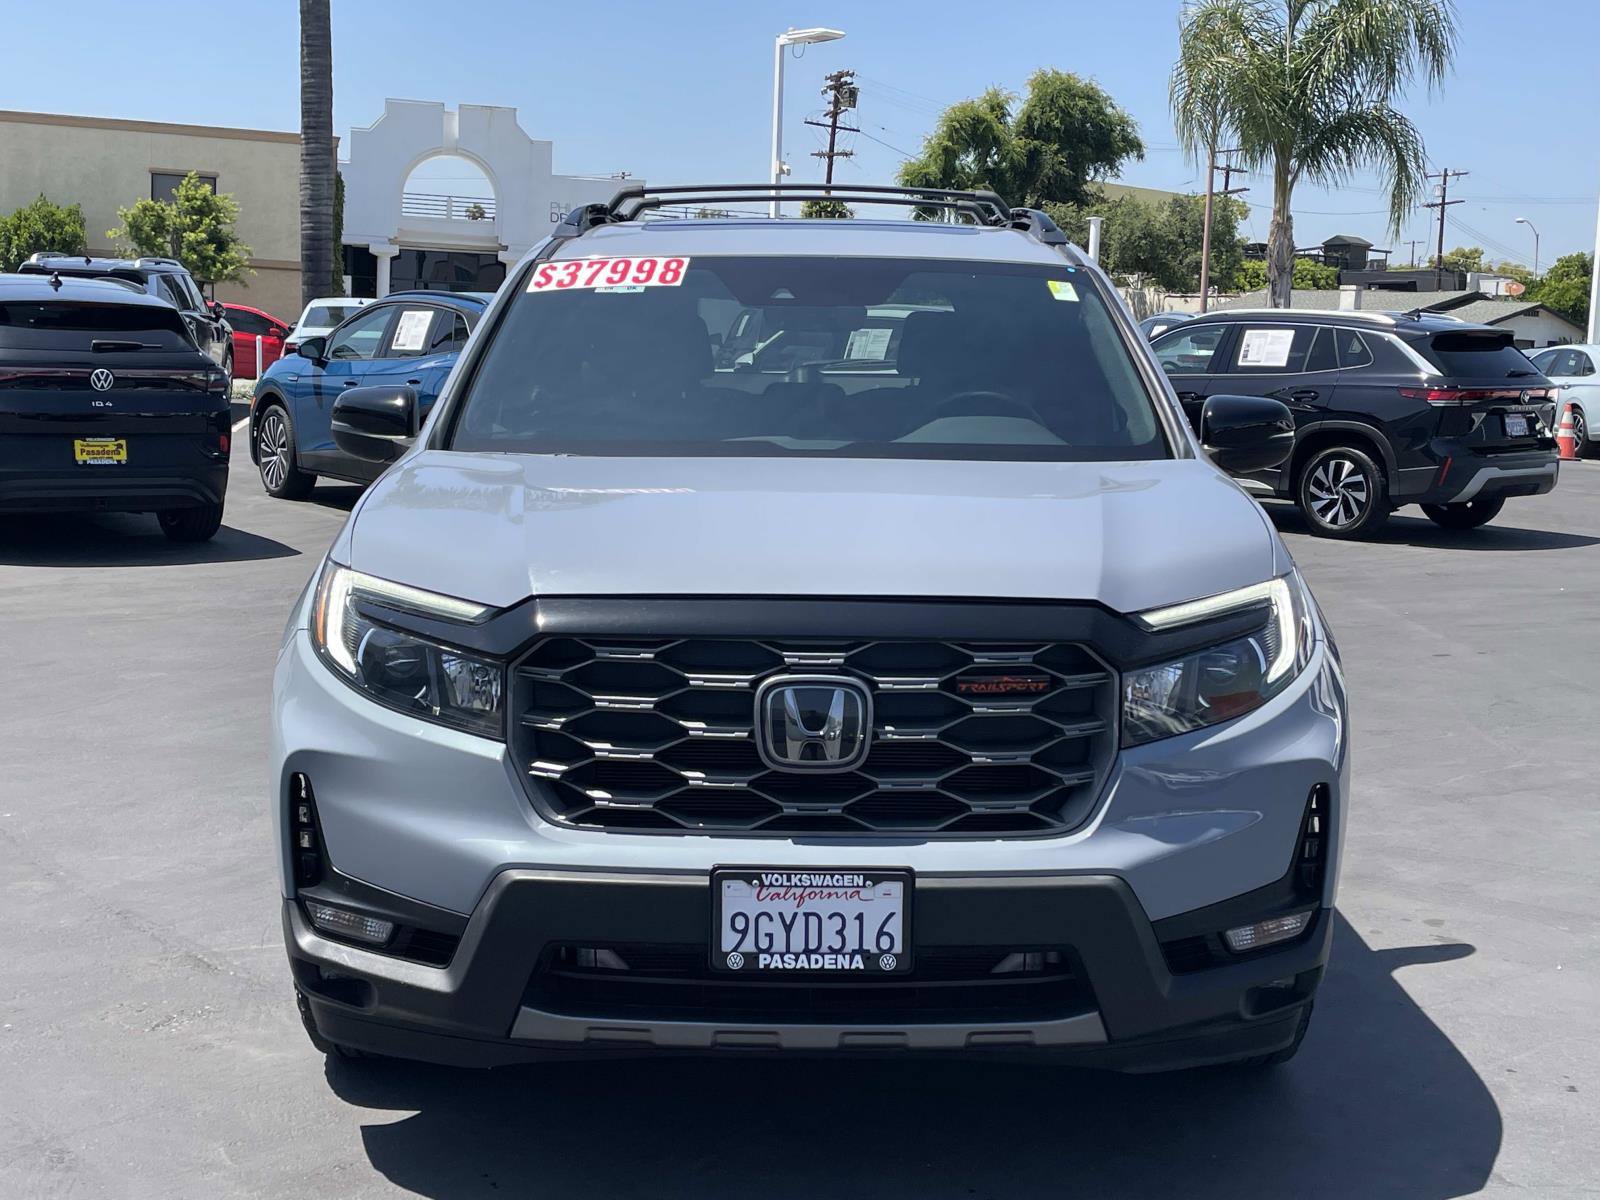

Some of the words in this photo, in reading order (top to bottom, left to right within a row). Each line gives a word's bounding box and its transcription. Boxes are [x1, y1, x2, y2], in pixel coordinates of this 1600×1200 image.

[534, 258, 685, 289] $37998
[760, 873, 864, 888] VOLKSWAGEN
[756, 884, 875, 909] California
[729, 911, 897, 953] 9GYD316
[758, 953, 865, 970] PASADENA
